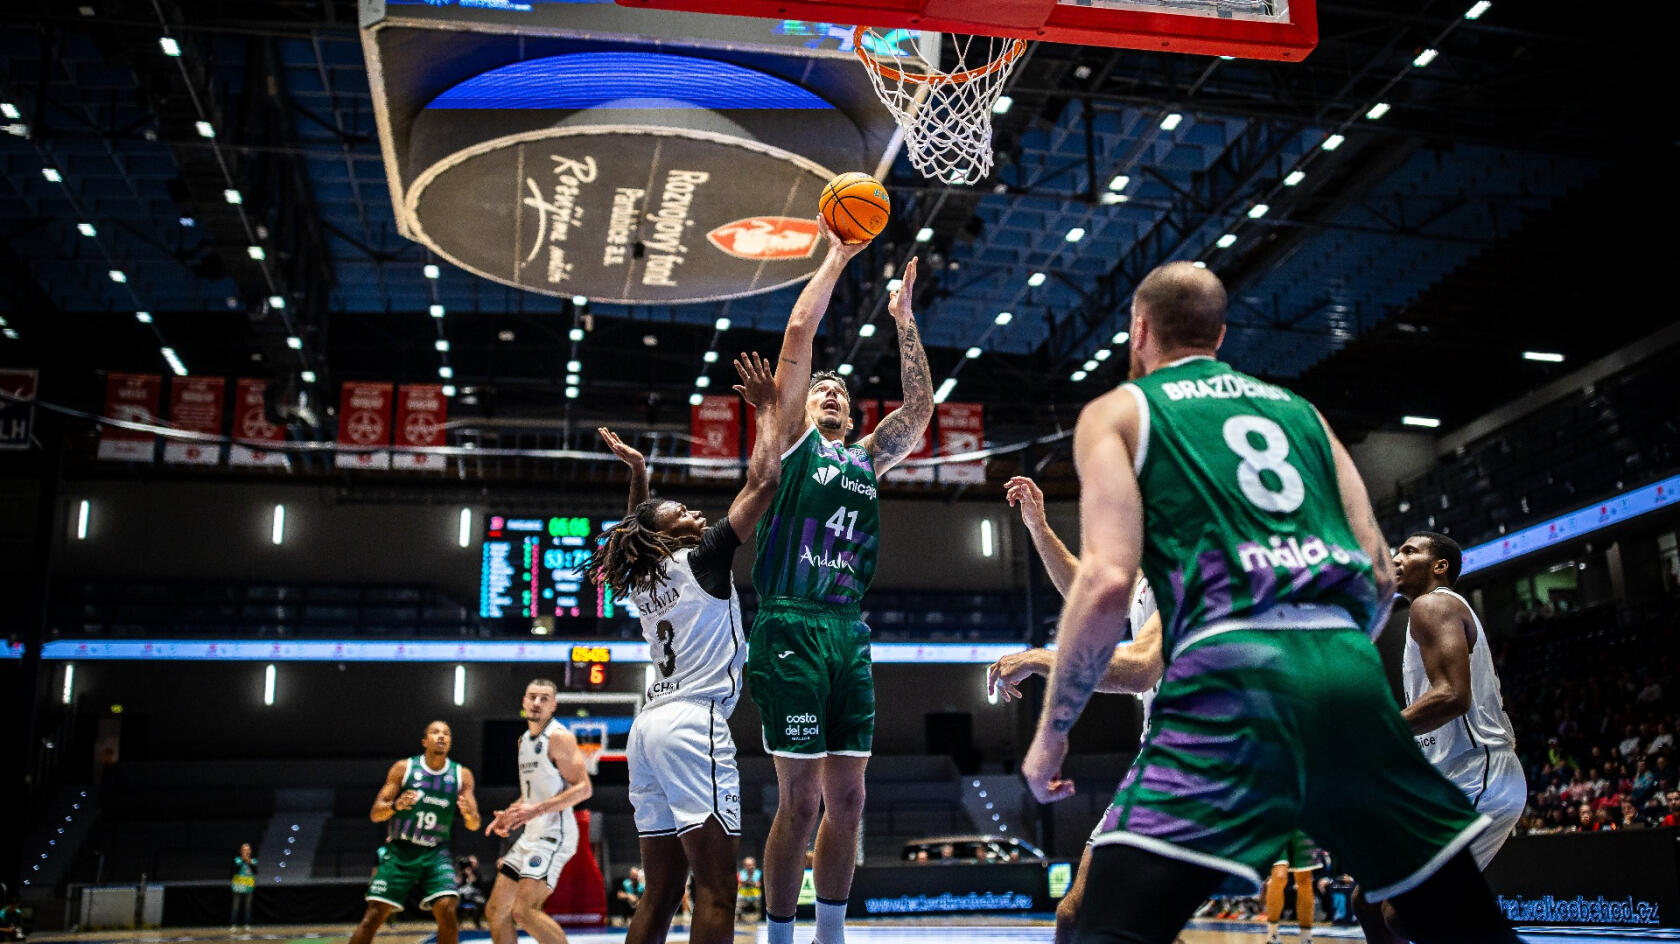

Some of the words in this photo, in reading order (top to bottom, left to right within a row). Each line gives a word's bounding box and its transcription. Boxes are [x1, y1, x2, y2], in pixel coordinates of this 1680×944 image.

[642, 169, 710, 253] Rozvojový
[641, 255, 684, 288] fond
[1222, 414, 1306, 513] 8
[841, 475, 877, 501] Unicaja
[825, 506, 859, 540] 41
[638, 587, 681, 616] SLAVIA
[656, 619, 677, 678] 3
[590, 663, 606, 685] 6
[785, 724, 801, 736] del
[802, 724, 819, 736] sol
[786, 712, 818, 724] costa
[416, 810, 438, 831] 19
